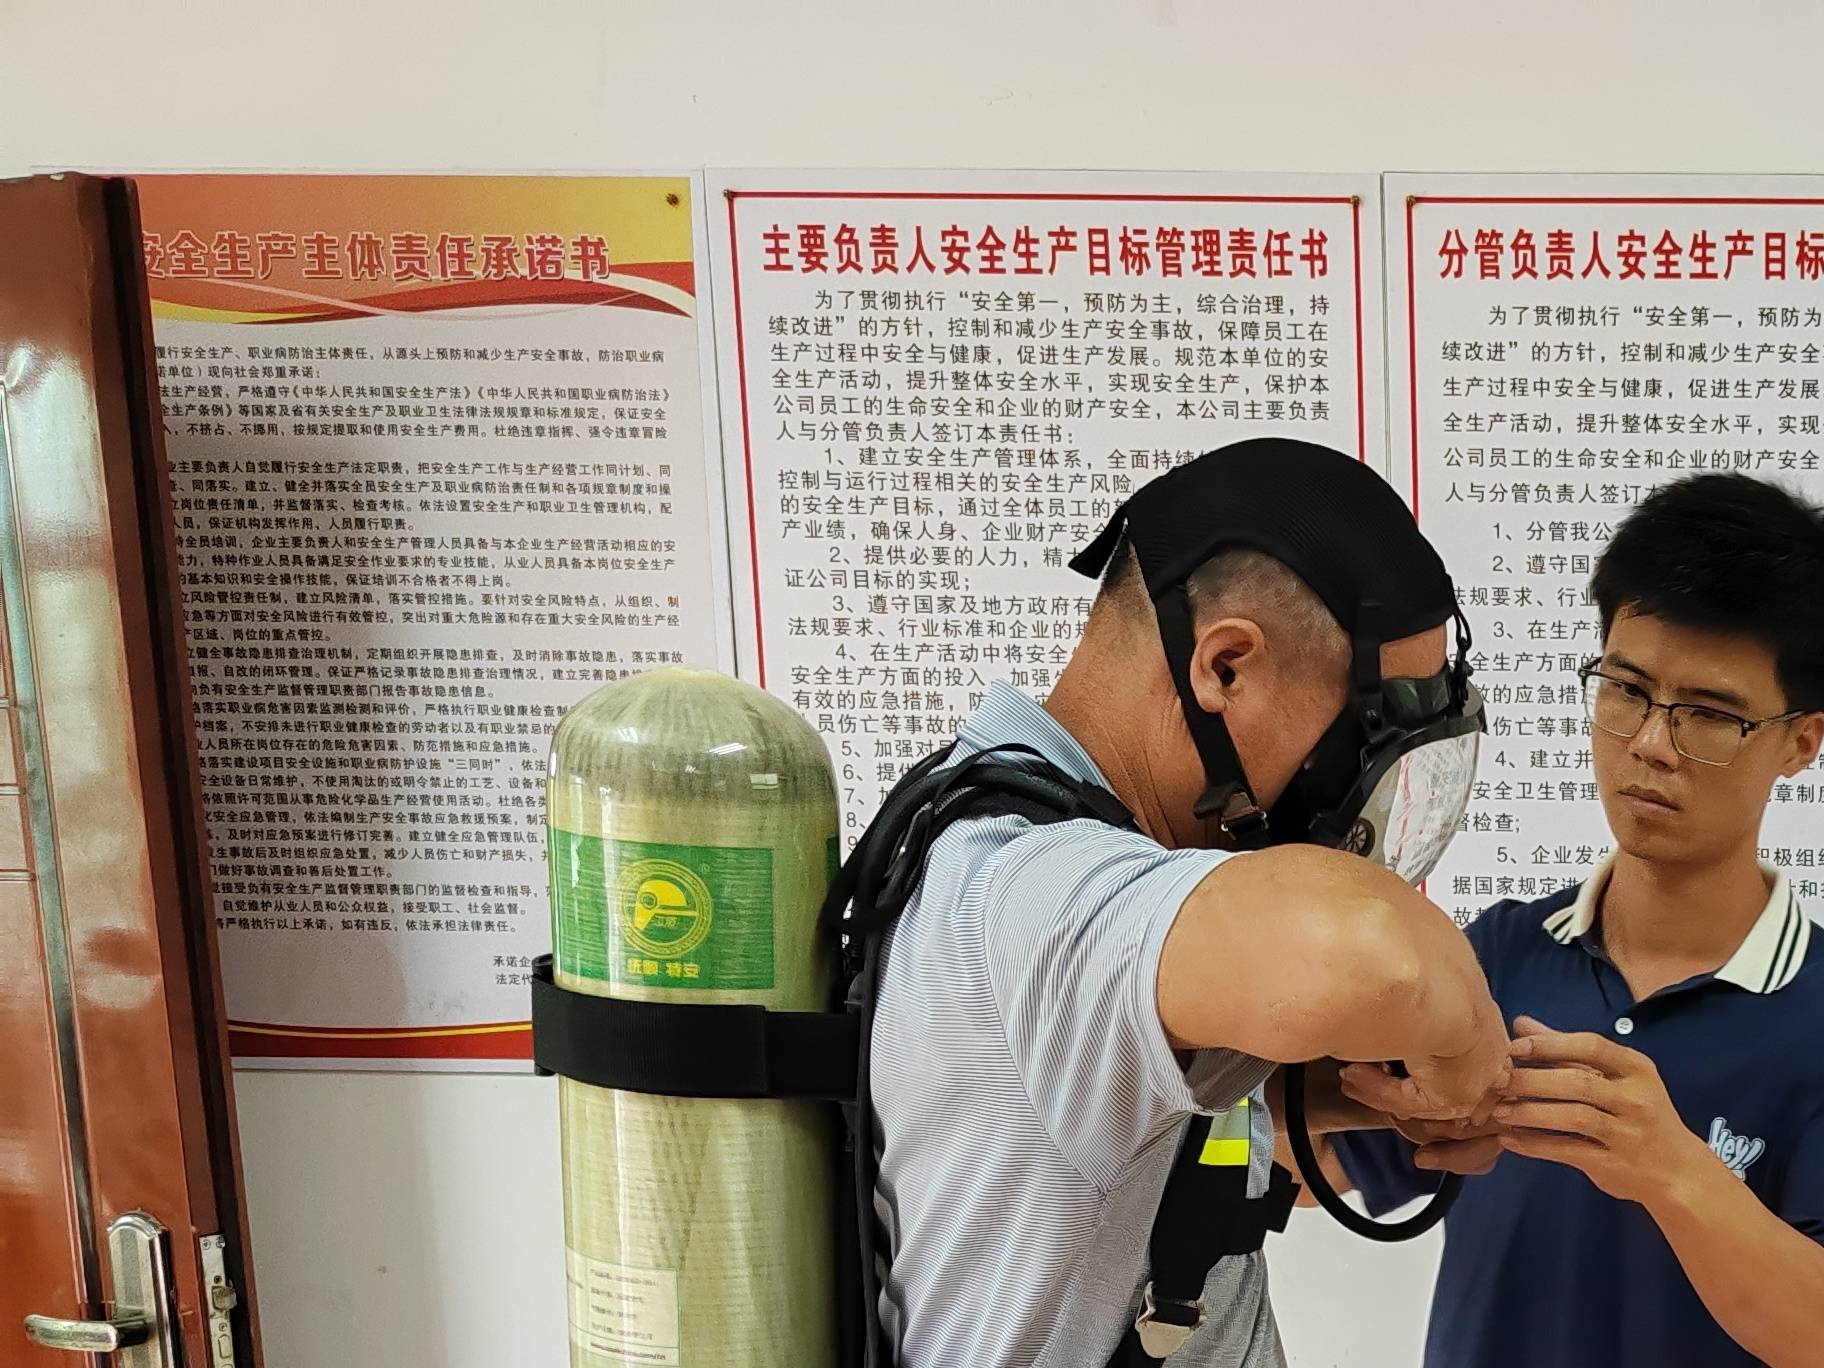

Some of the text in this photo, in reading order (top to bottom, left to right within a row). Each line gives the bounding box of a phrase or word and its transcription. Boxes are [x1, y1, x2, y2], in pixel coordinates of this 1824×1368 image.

[762, 222, 1329, 279] 主要负责人安全生产目标管理责任书
[771, 342, 1329, 369] 生产过程中安全与健康，促进生产发展。规范本单位的安
[771, 368, 1329, 395] 全生产活动，提升整体安全水平，实现安全生产，保护本
[774, 395, 1329, 421] 公司员工的生命安全和企业的财产安全，本公司主要负责
[824, 447, 1209, 470] 1、建立安全生产管理体系，全面持续
[1492, 554, 1601, 574] 2、遵守国
[835, 643, 1075, 665] 4、在生产活动中将安全
[801, 712, 967, 735] 员伤亡等事故的
